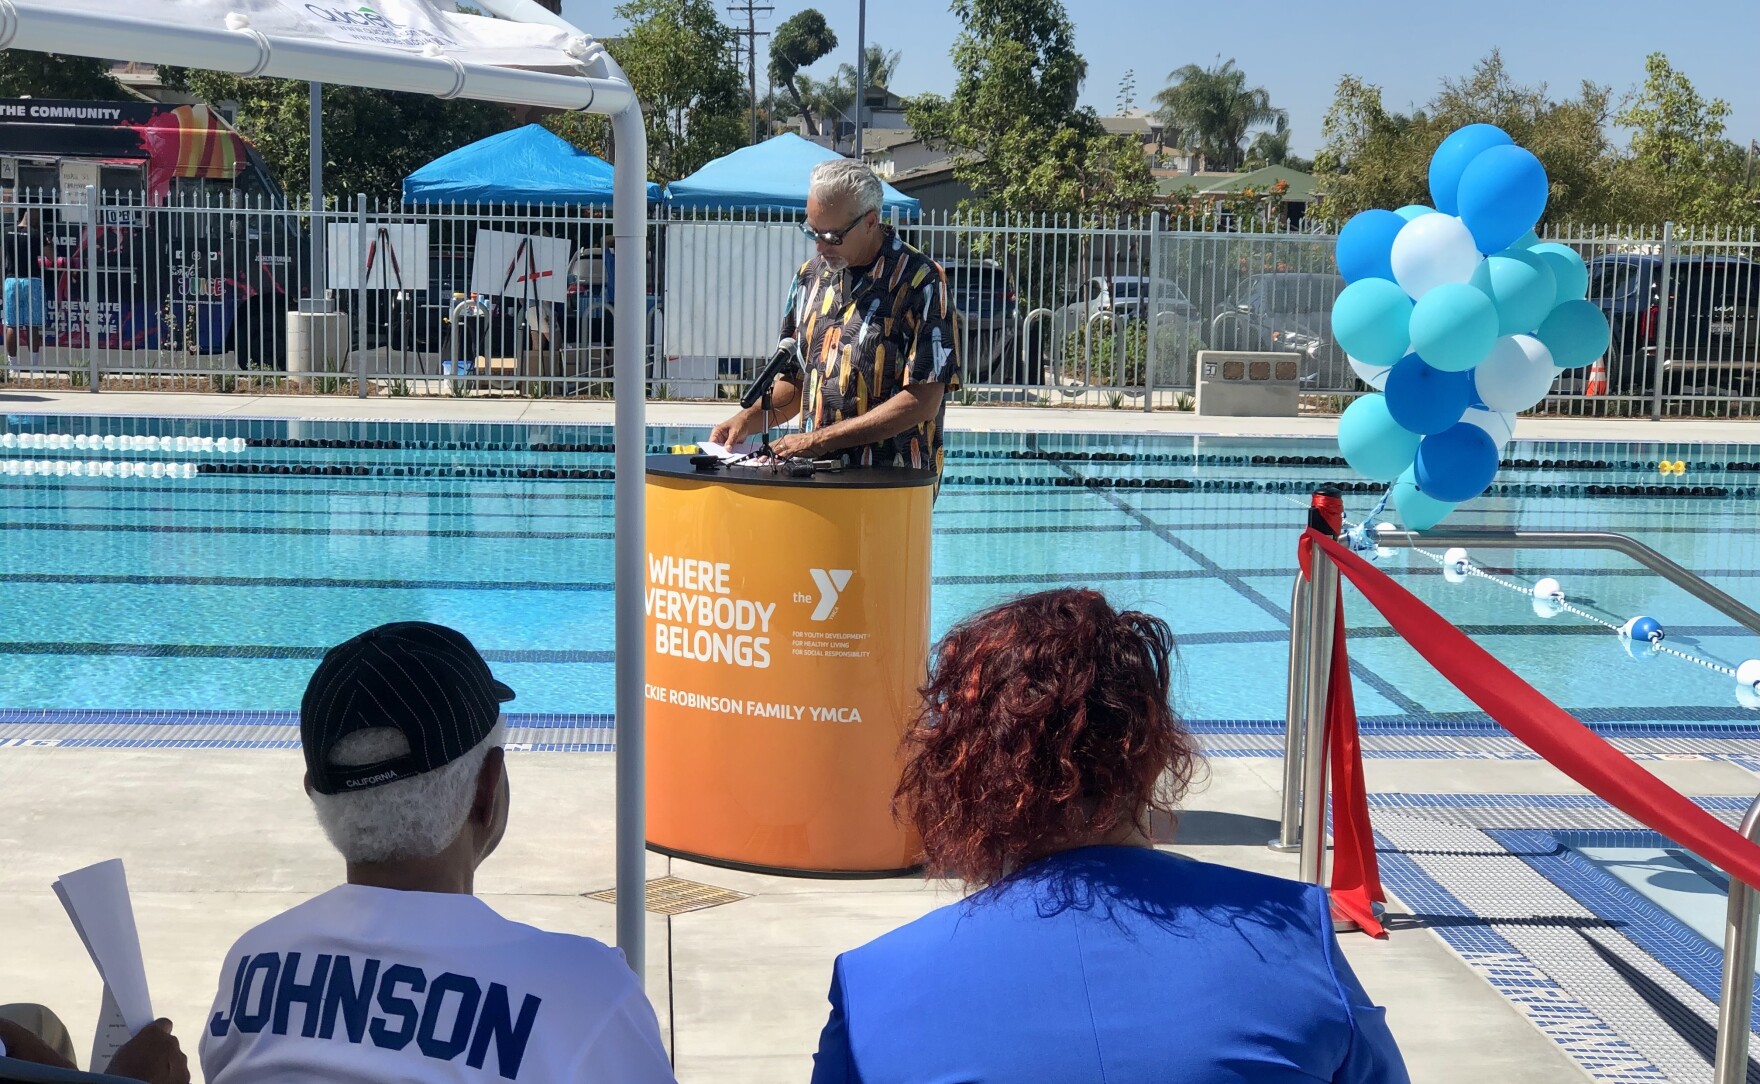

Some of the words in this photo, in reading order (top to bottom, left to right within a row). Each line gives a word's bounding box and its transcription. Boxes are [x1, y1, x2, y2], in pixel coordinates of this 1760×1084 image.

[0, 105, 26, 117] THE
[30, 106, 121, 120] COMMUNITY
[61, 301, 120, 312] REWITE
[84, 324, 117, 334] TME
[648, 552, 731, 594] WHERE
[793, 591, 812, 604] the
[645, 586, 776, 633] VERYBODY
[655, 623, 771, 669] BELONGS
[804, 640, 829, 648] HEALTHY
[792, 648, 804, 656] FOR
[804, 649, 824, 657] SOCIAL
[825, 650, 871, 658] RESPONSIBILITY
[645, 683, 667, 703] CKIE
[669, 689, 743, 715] ROBINSON
[746, 701, 806, 721] FAMILY
[809, 706, 863, 723] YMCA
[346, 769, 398, 788] CALIFORNIA
[209, 951, 542, 1082] JOHNSON
